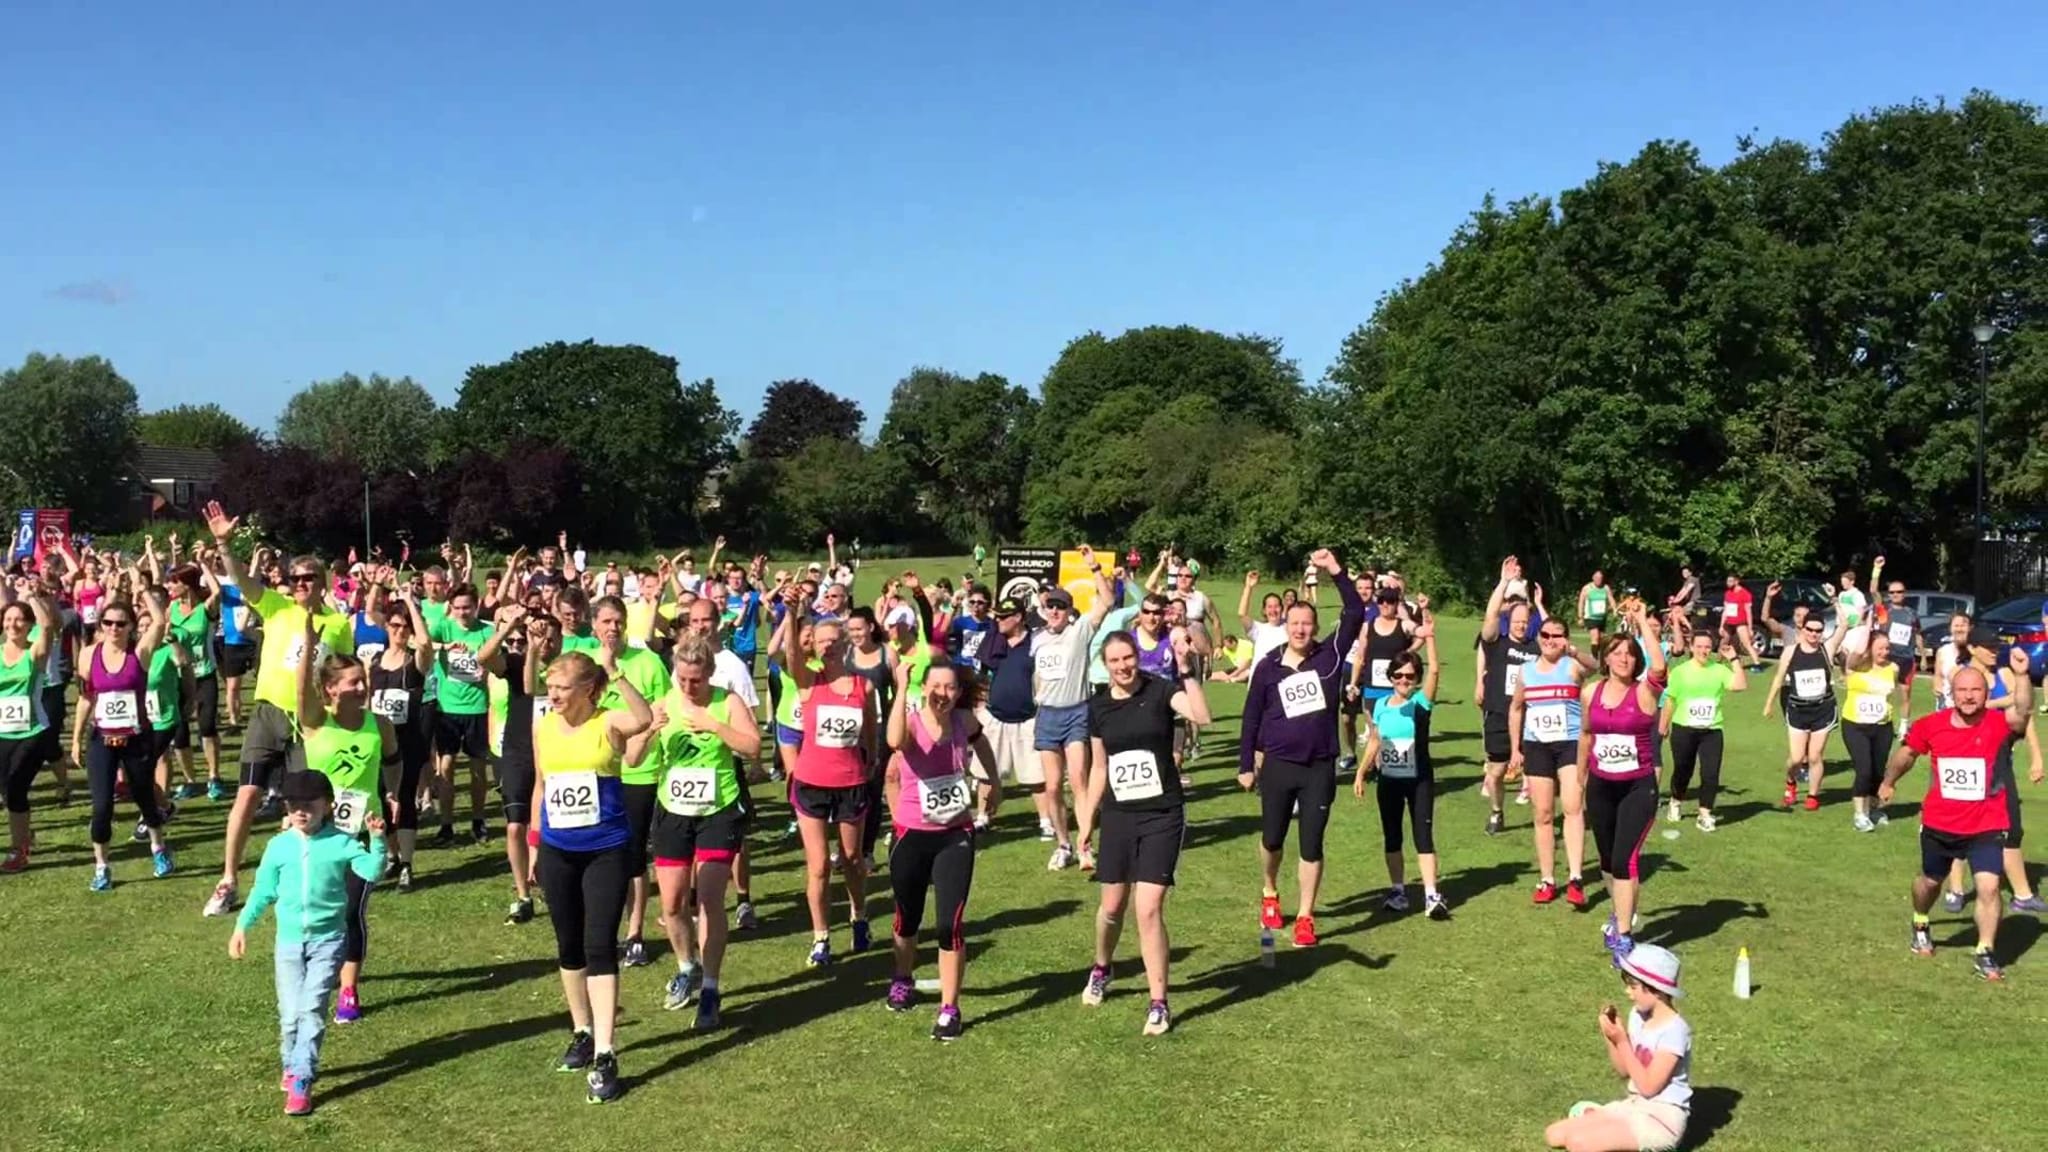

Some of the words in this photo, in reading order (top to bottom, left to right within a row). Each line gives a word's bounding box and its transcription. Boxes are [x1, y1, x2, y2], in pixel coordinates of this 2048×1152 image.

[1039, 654, 1062, 669] 520
[1285, 681, 1317, 702] 650
[105, 700, 127, 715] 82
[375, 699, 404, 712] 463
[1689, 705, 1713, 717] 607
[1859, 702, 1883, 714] 610
[821, 717, 857, 734] 432
[1534, 714, 1562, 729] 194
[1382, 749, 1408, 764] 631
[1598, 744, 1632, 759] 363
[1115, 761, 1152, 784] 275
[1945, 768, 1977, 785] 281
[550, 785, 593, 808] 462
[671, 780, 709, 799] 627
[926, 785, 965, 810] 559
